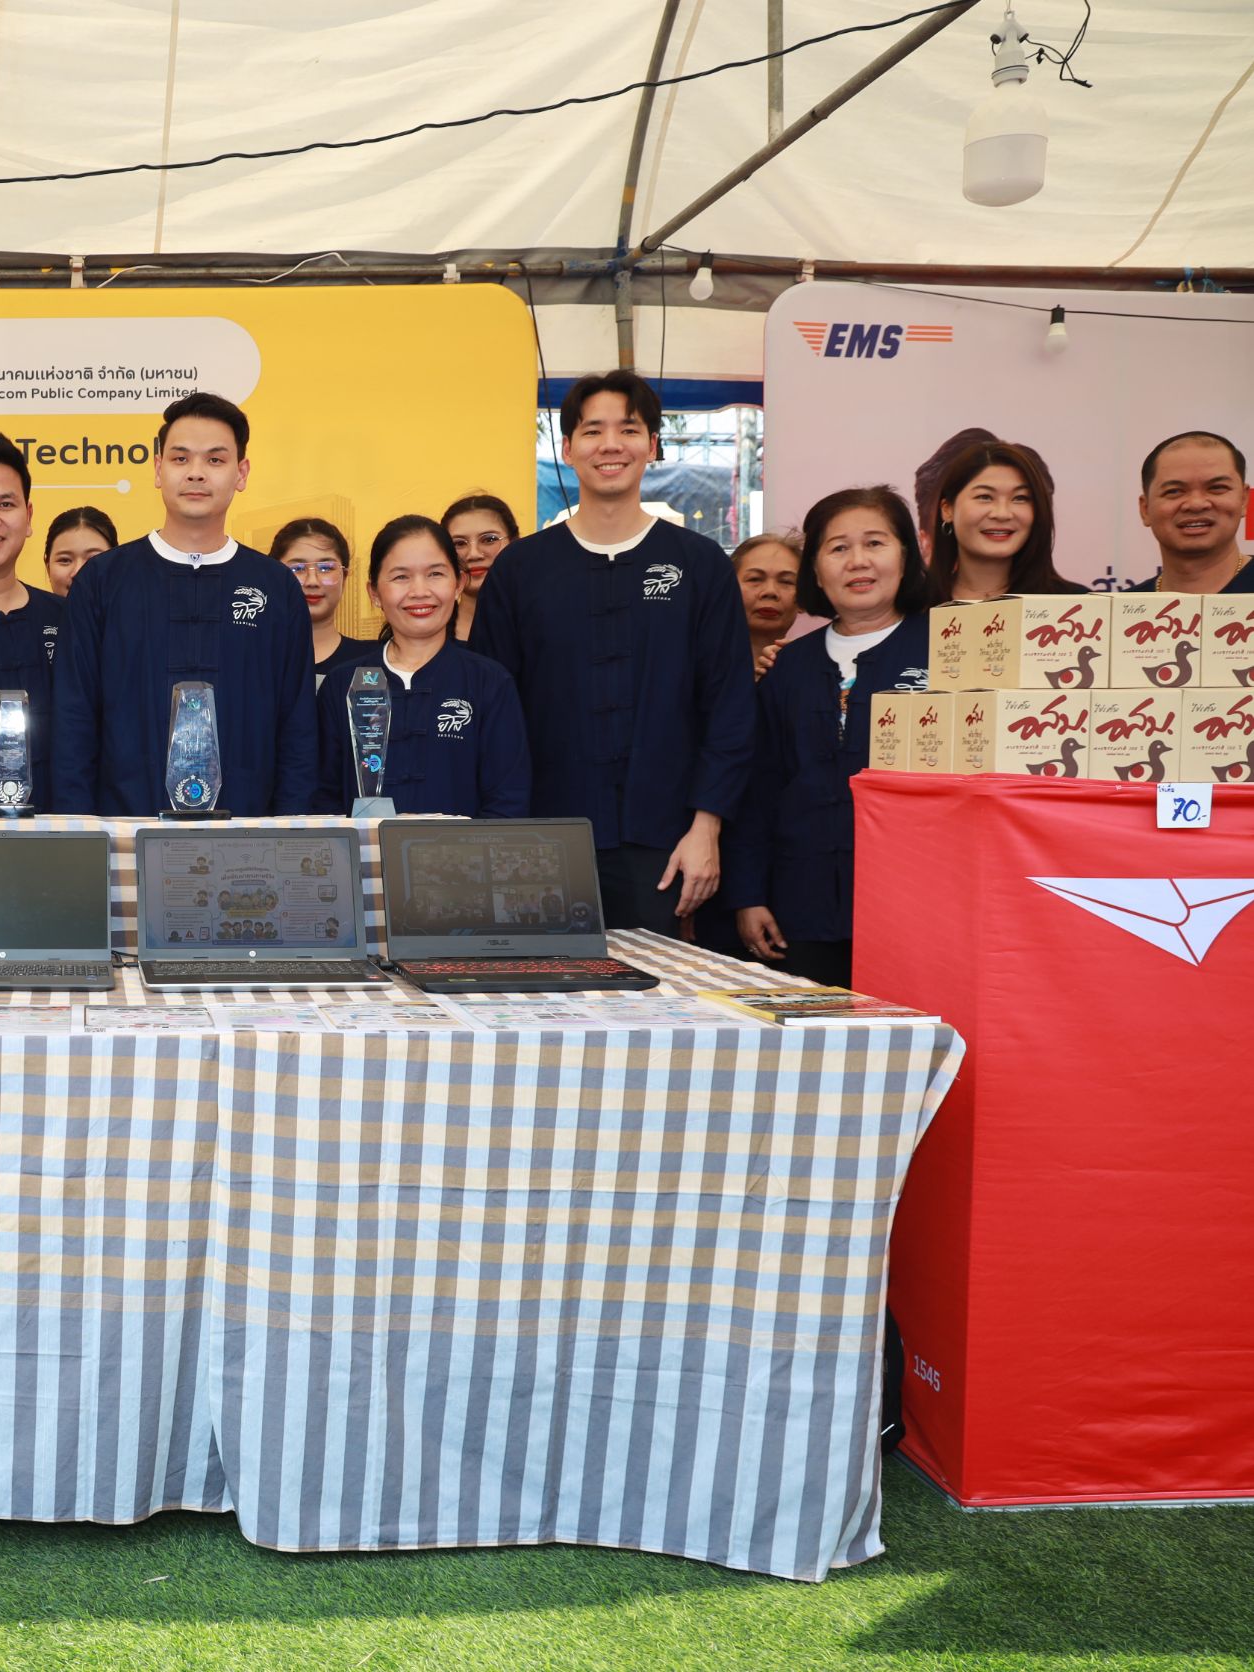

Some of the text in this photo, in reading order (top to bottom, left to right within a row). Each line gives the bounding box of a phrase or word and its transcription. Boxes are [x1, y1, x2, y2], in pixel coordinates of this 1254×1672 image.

[824, 323, 904, 359] EMS
[98, 366, 135, 380] จำกัด
[140, 366, 198, 381] (มหาชน)
[31, 388, 73, 399] Public
[77, 387, 142, 400] Company
[15, 436, 161, 465] Technol
[913, 1355, 941, 1392] 1545
